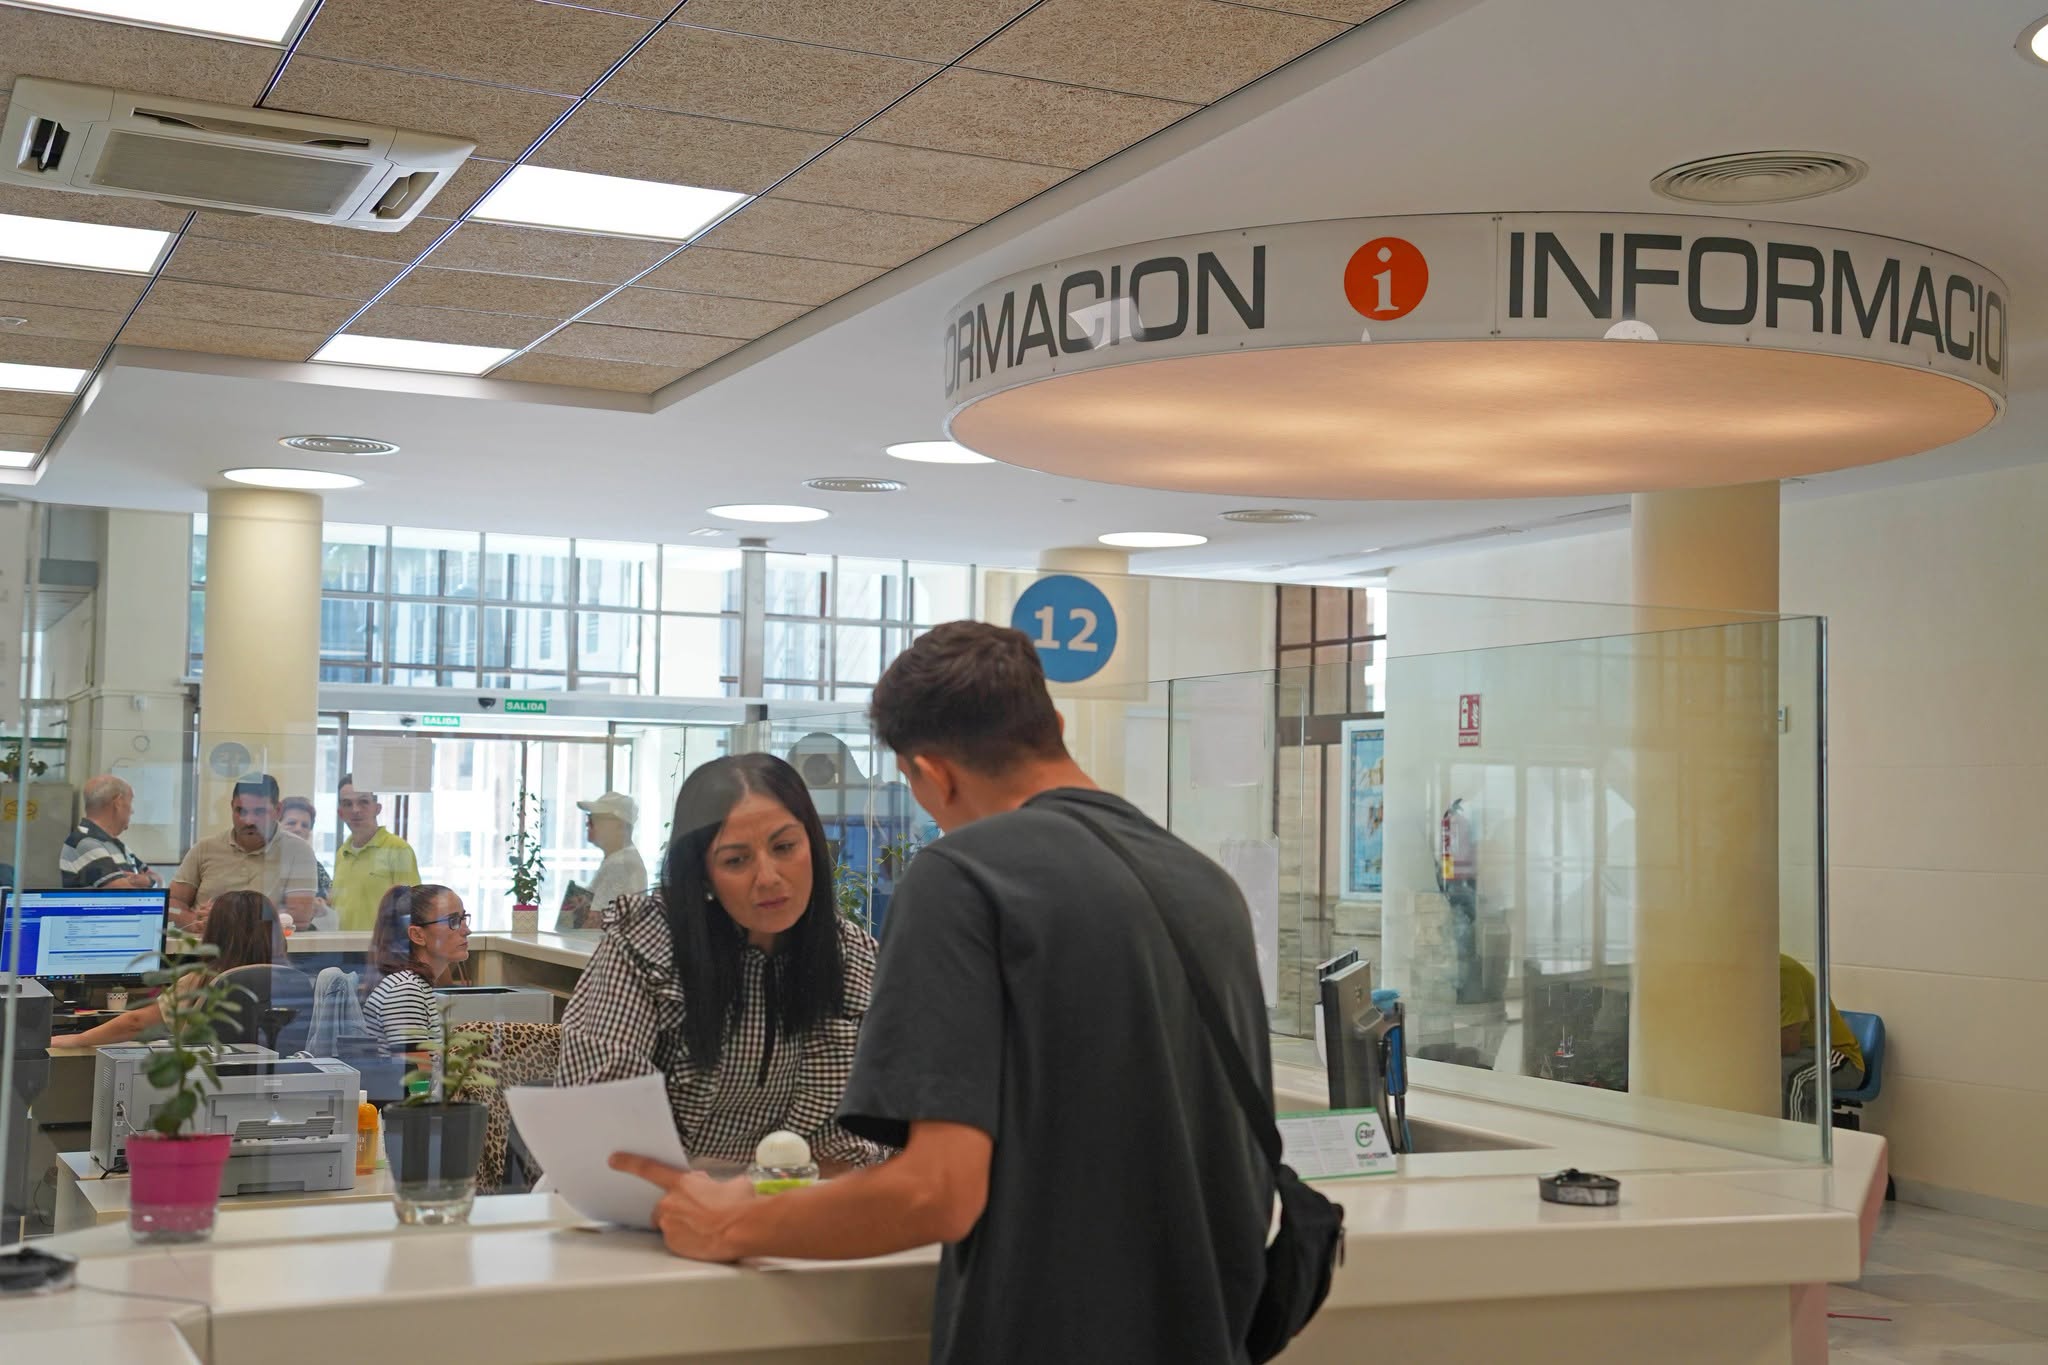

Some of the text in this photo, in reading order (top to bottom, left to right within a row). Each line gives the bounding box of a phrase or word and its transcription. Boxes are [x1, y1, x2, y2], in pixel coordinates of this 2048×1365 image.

[1033, 605, 1098, 652] 12
[506, 701, 545, 712] SALIDA
[424, 716, 459, 726] SALIDA
